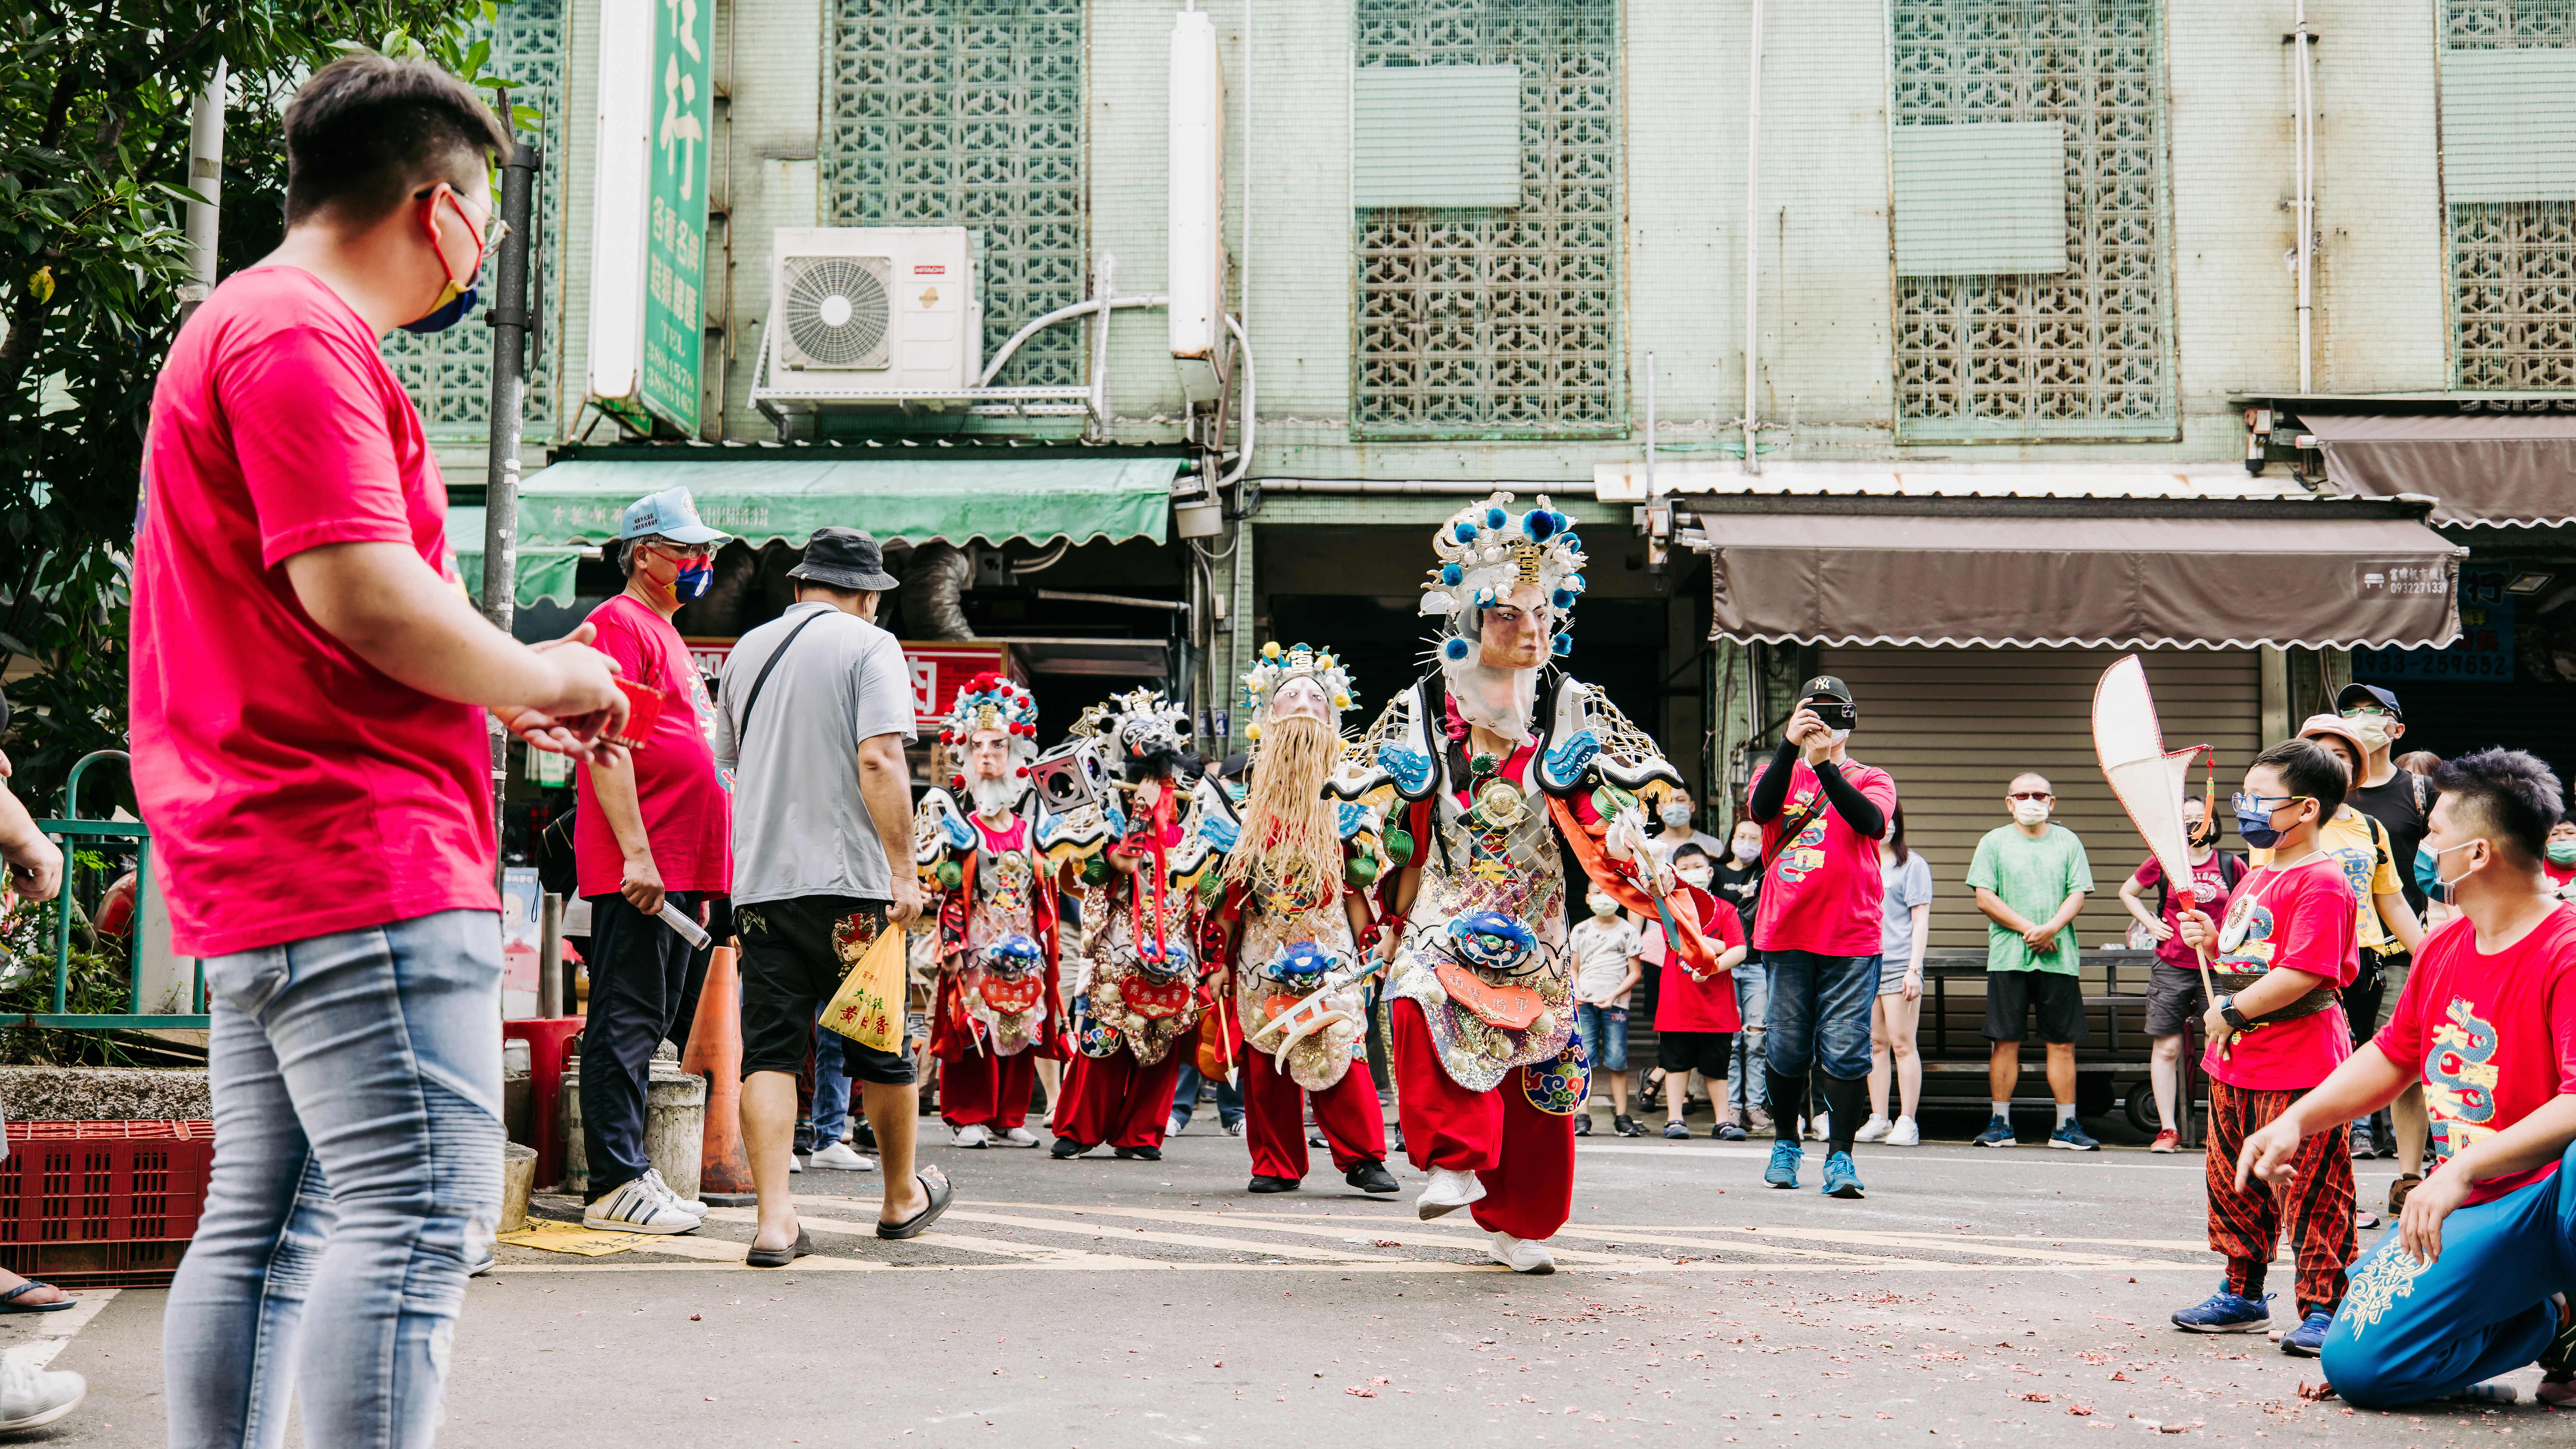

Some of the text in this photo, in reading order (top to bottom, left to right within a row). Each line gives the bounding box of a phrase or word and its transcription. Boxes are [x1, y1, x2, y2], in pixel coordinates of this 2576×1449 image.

[661, 319, 686, 357] TEL
[647, 340, 695, 393] 3881578
[2353, 653, 2506, 676] 0933-259652
[1815, 677, 1830, 690] NY
[840, 1005, 889, 1036] 黃日香
